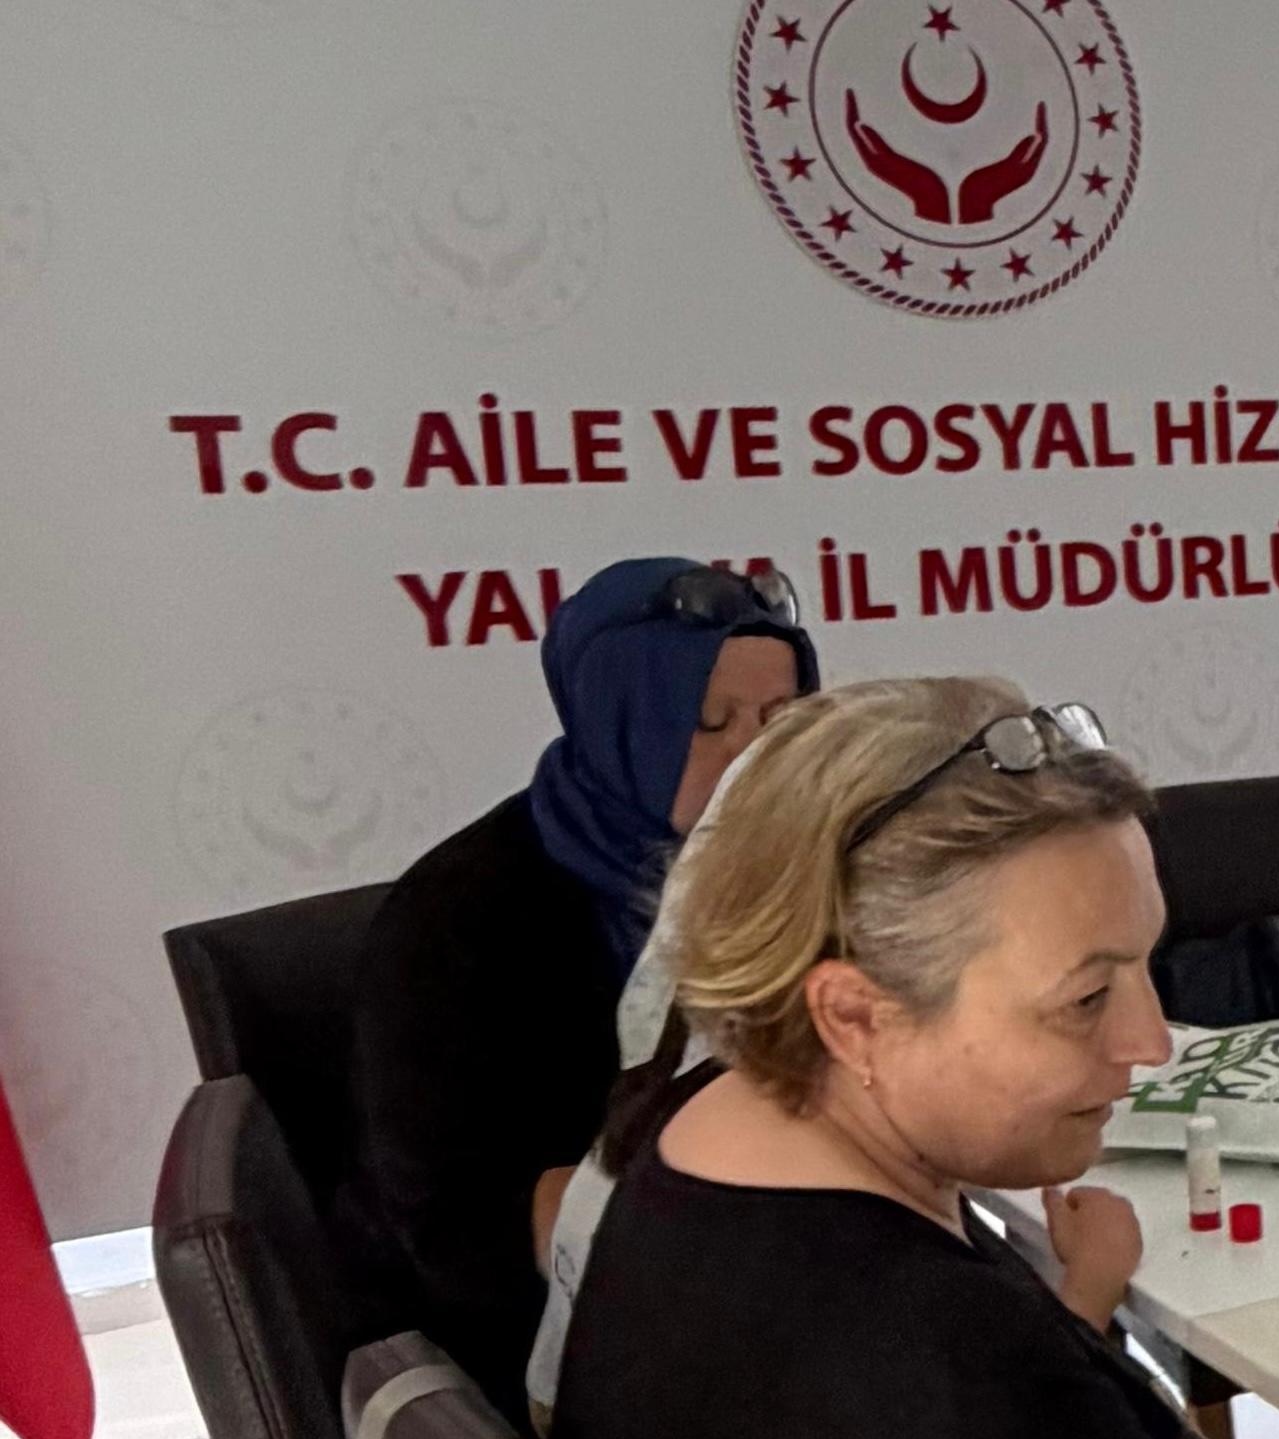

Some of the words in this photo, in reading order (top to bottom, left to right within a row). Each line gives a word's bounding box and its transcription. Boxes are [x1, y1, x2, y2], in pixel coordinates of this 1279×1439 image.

[170, 413, 374, 497] T.C.
[404, 393, 627, 489] AİLE
[652, 407, 781, 483] VE
[807, 402, 1134, 477] SOSYAL
[817, 538, 897, 624] İL
